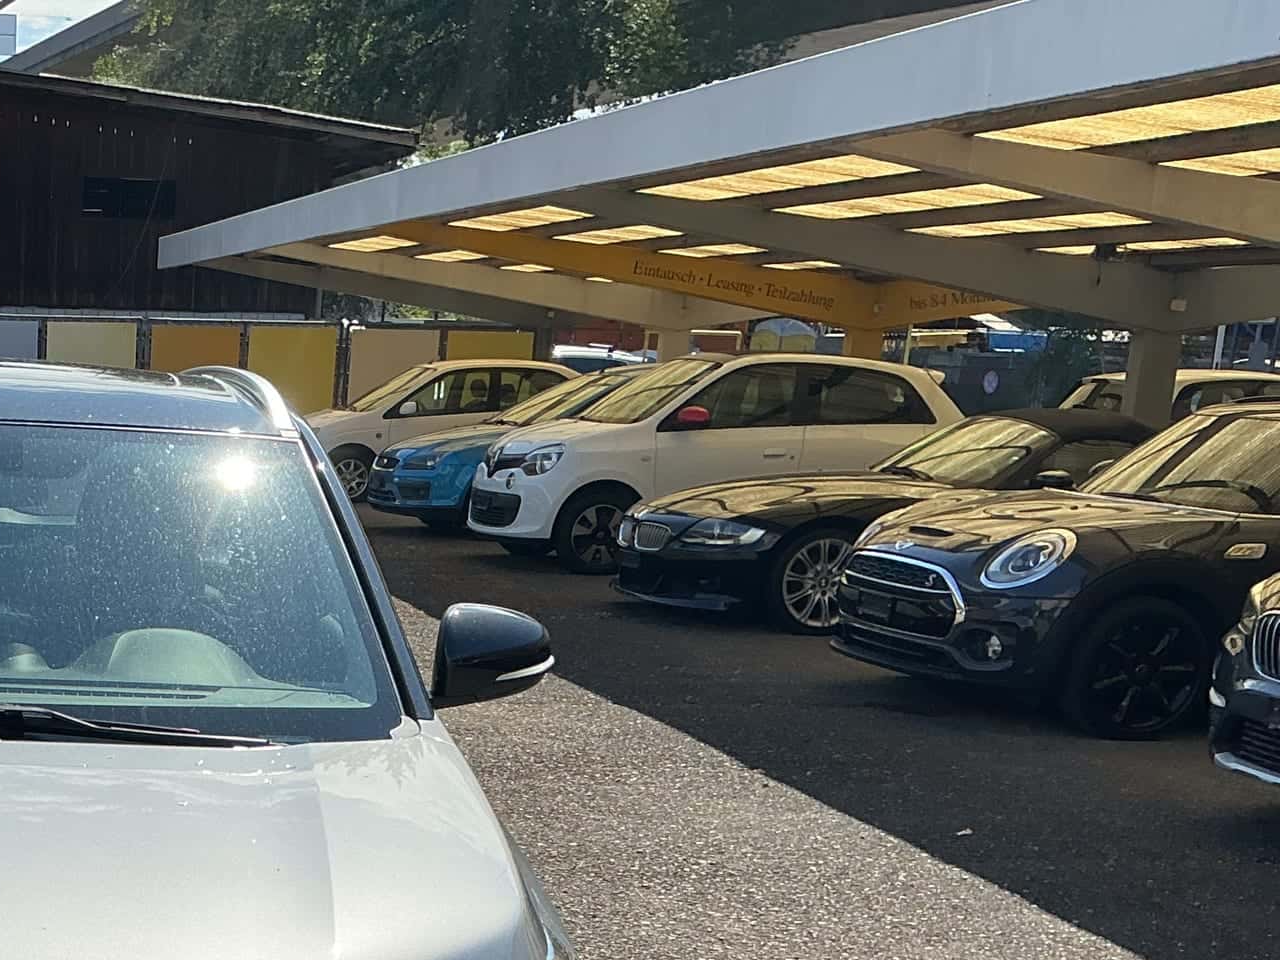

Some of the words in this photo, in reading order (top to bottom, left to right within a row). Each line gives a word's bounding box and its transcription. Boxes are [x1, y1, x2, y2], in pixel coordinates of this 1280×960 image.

[632, 260, 697, 285] Eintausch
[706, 274, 755, 297] Leasing
[764, 282, 836, 311] Teilzahlung
